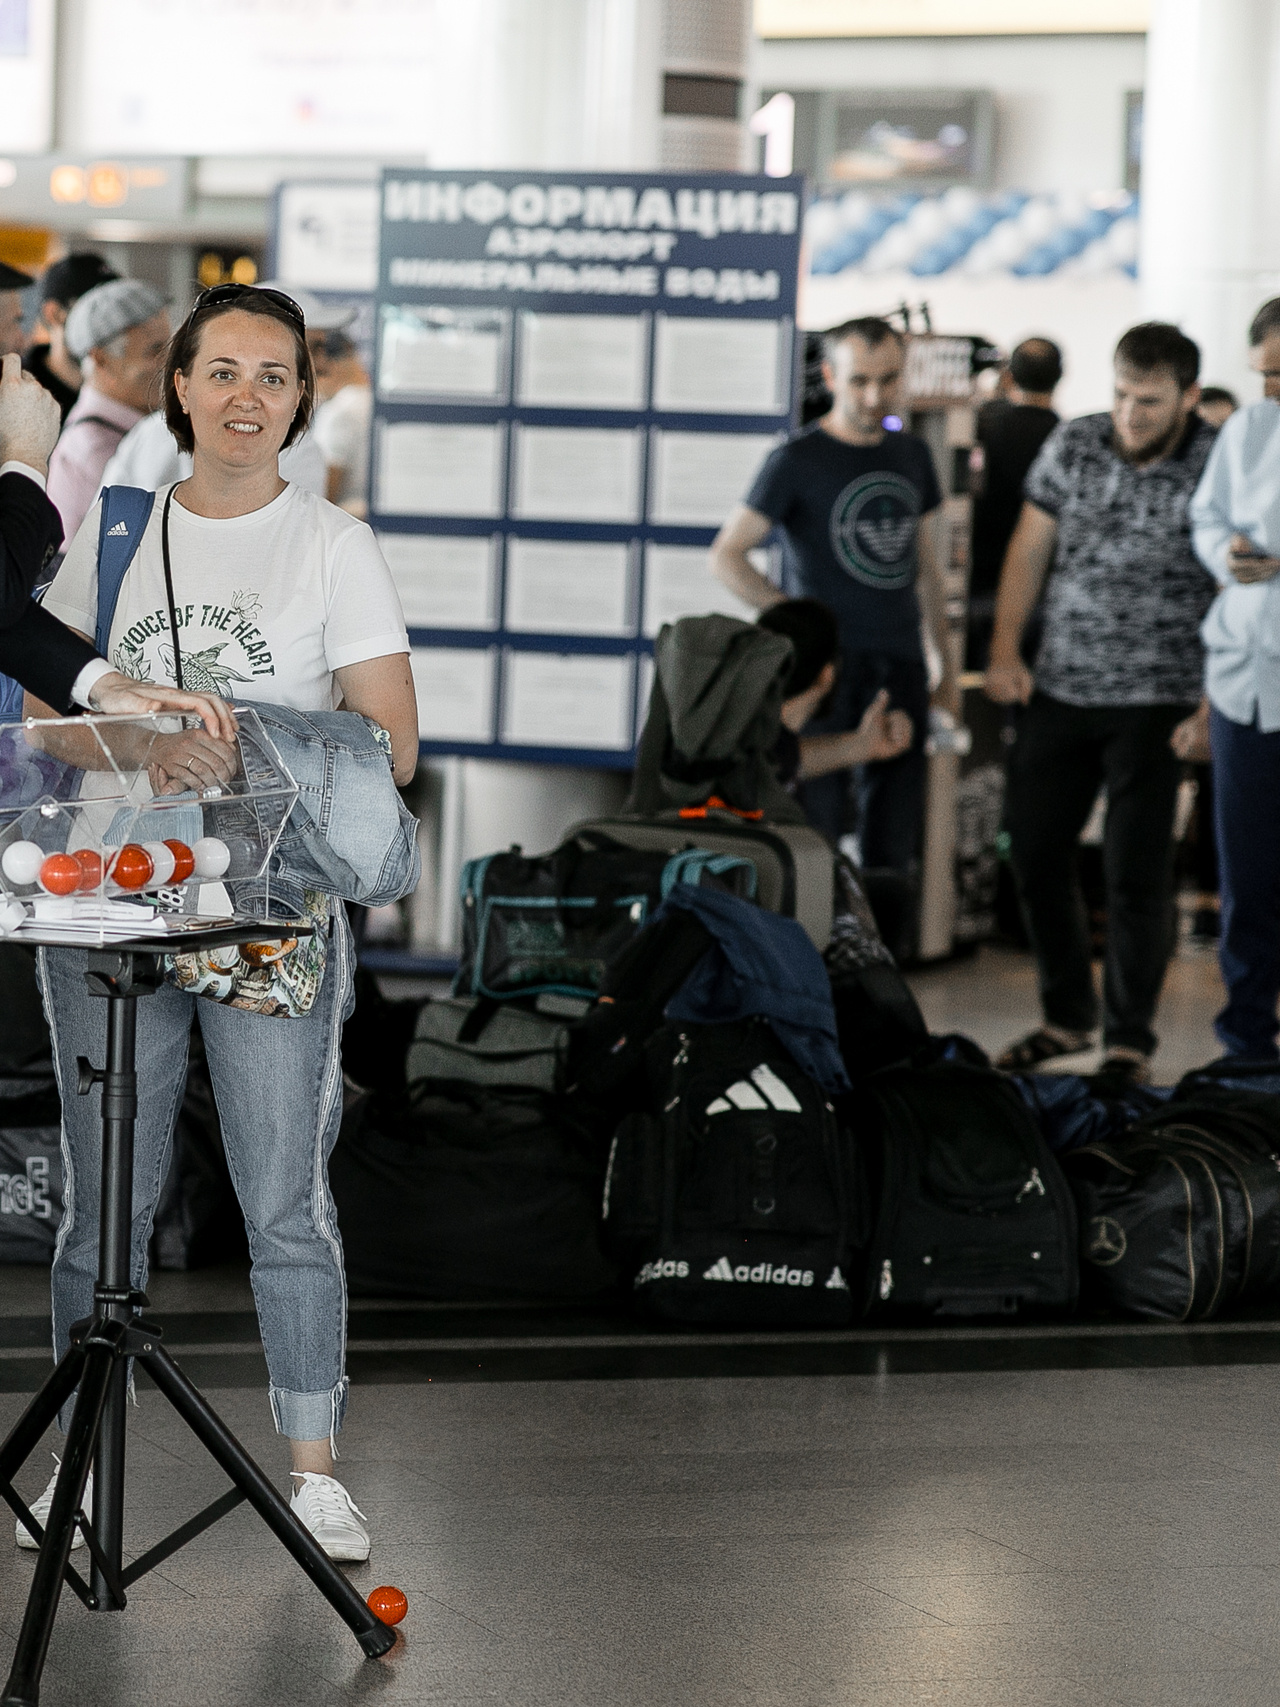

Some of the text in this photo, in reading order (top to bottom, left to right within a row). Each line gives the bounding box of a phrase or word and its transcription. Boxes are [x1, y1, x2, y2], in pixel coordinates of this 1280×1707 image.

[383, 180, 799, 238] ИНФОРМАЦИЯ
[486, 226, 677, 262] АЭРОПОРТ
[388, 257, 781, 303] МИНЕРАЛЬНЫЕ ВОДЫ
[120, 604, 275, 676] VOICE OF THE HEART
[734, 1262, 815, 1288] adidas
